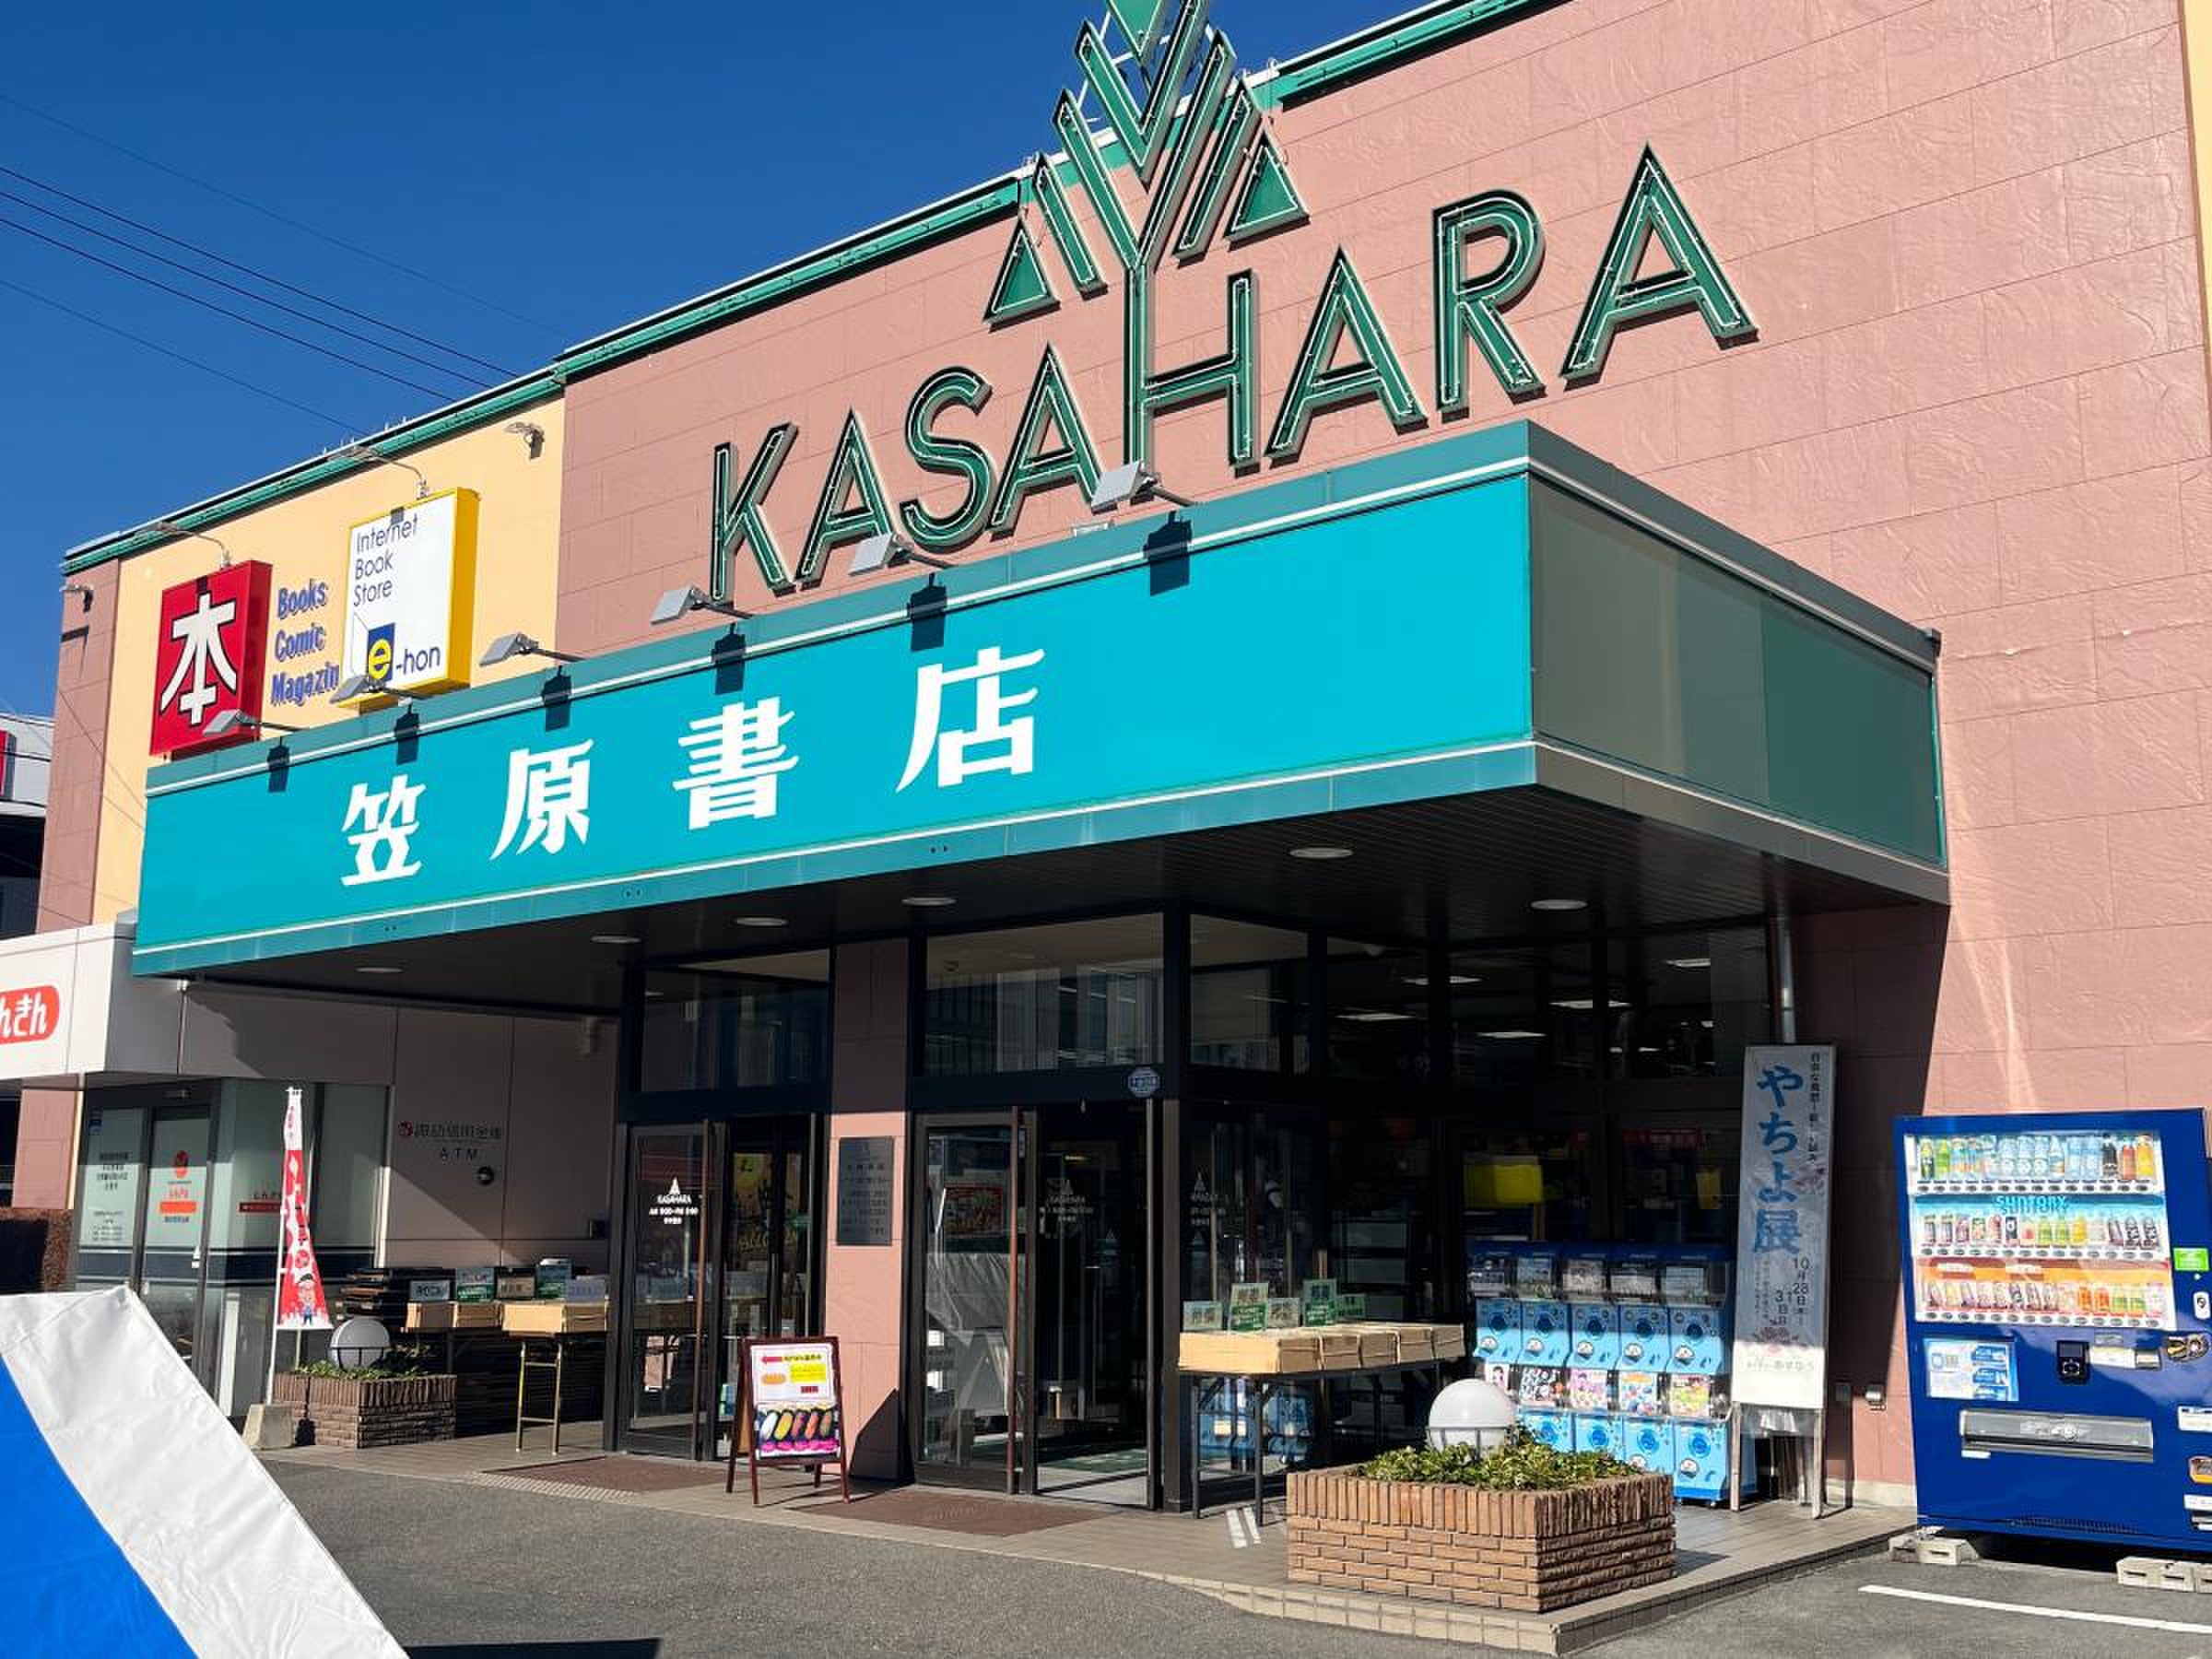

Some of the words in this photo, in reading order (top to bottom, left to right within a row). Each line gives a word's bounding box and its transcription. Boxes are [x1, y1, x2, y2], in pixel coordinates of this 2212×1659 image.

[712, 145, 1758, 602] KASAHARA
[357, 513, 418, 554] Internet
[355, 552, 394, 581] Book
[277, 579, 328, 620] Books
[353, 580, 394, 608] Store
[159, 592, 238, 725] 本
[275, 623, 326, 663] Comic
[369, 639, 441, 680] e-hon
[340, 645, 1045, 886] 笠原書店
[441, 1148, 477, 1161] ATM
[1753, 1065, 1804, 1254] やちよ展
